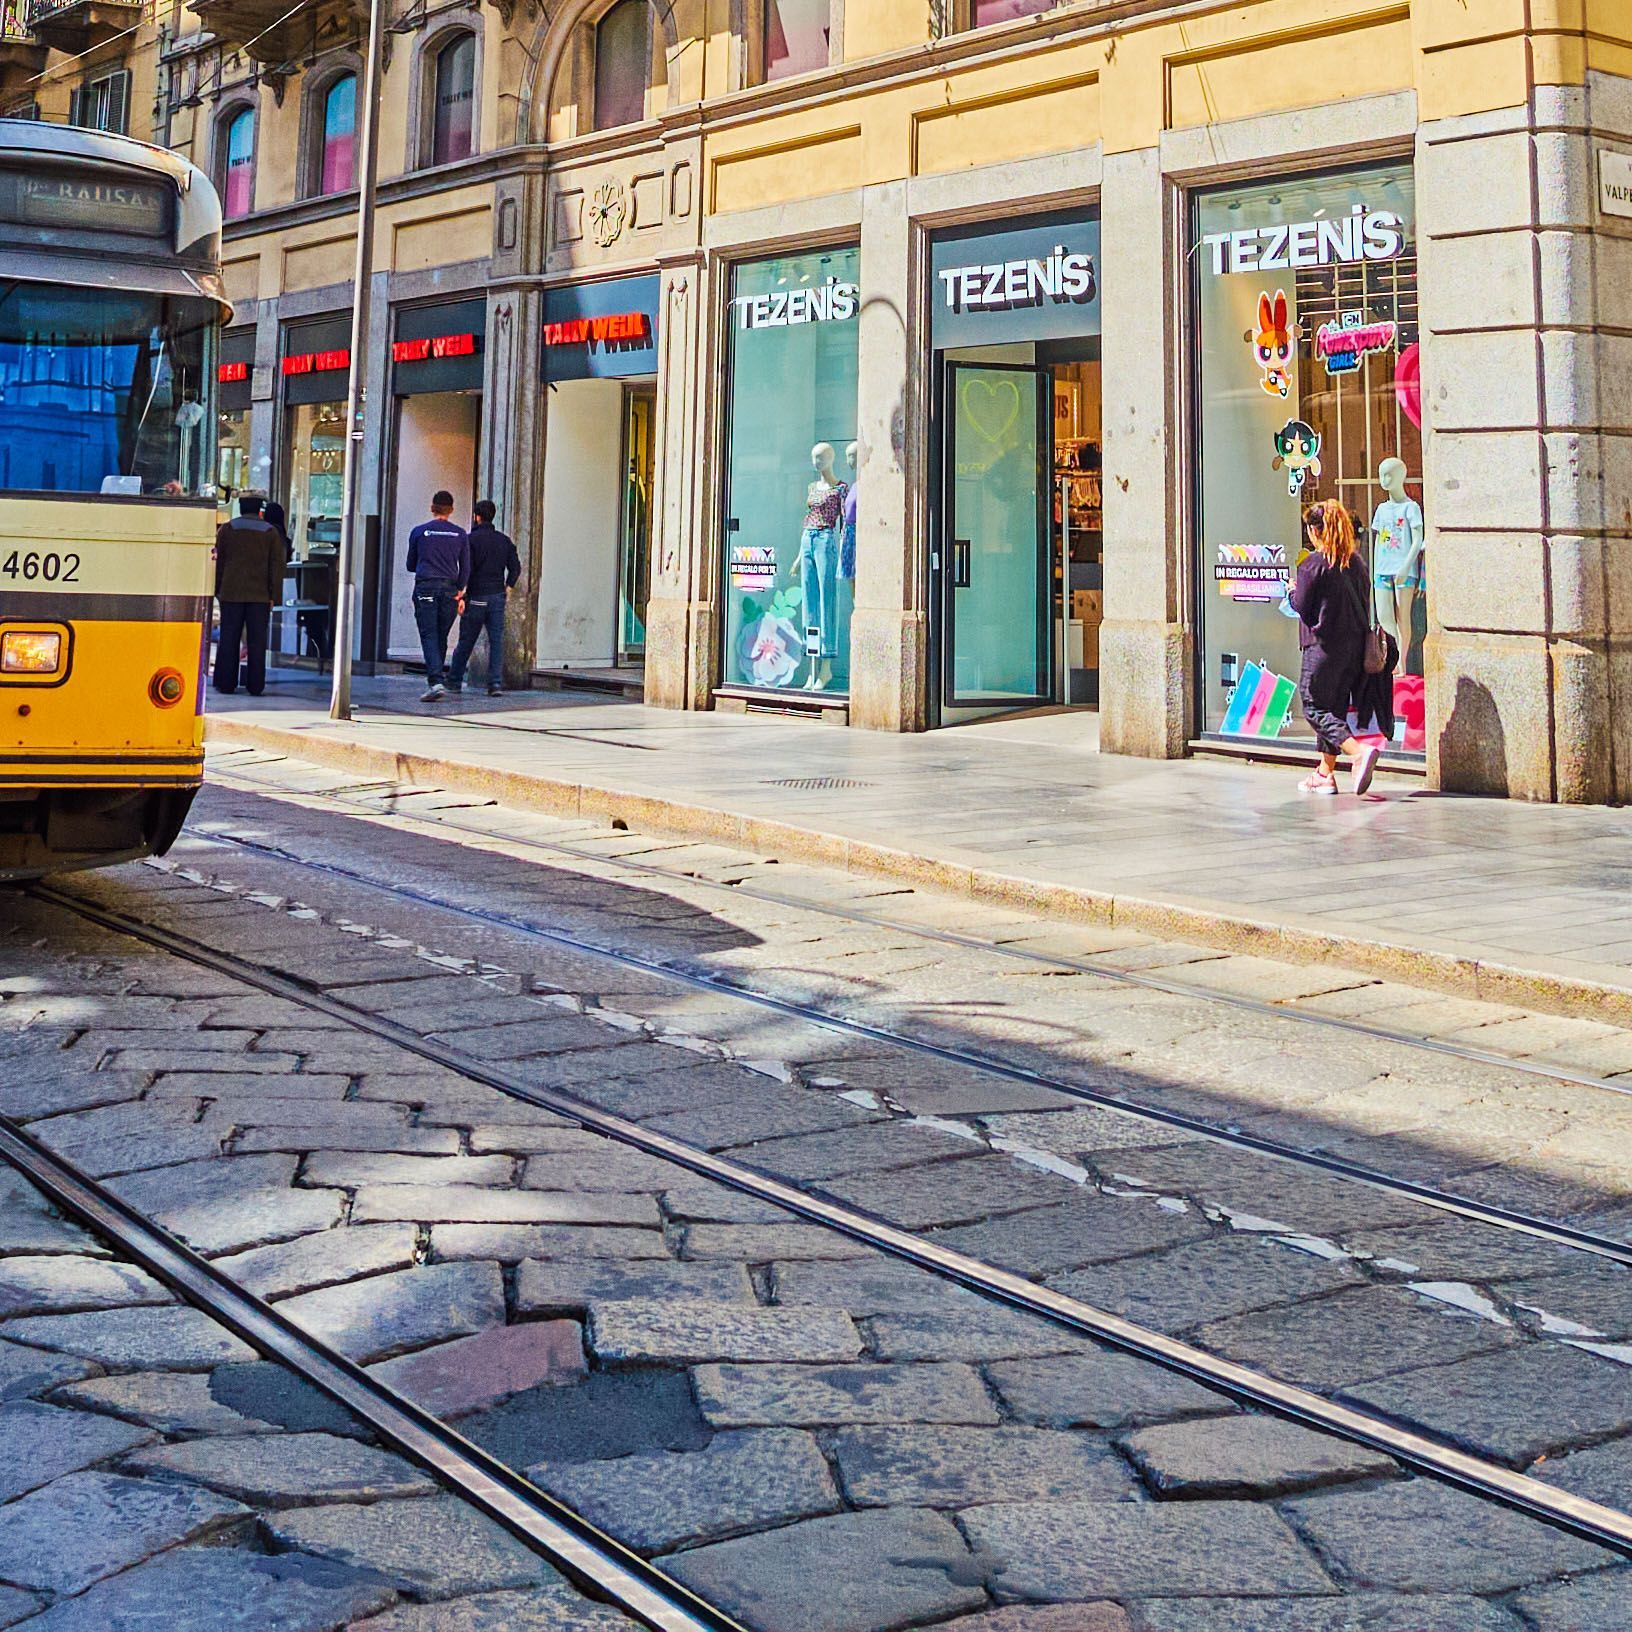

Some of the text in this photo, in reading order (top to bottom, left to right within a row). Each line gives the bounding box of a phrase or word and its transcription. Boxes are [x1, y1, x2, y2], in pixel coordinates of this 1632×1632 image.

[1203, 204, 1402, 275] TEZENIS
[938, 245, 1093, 307] TEZENIS
[736, 276, 857, 329] TEZENIS
[543, 317, 588, 346] TALLY
[392, 339, 430, 363] TALLY
[2, 550, 80, 582] 4602
[1215, 566, 1226, 578] IN
[1226, 567, 1259, 579] REGALO
[1259, 568, 1277, 580] PER
